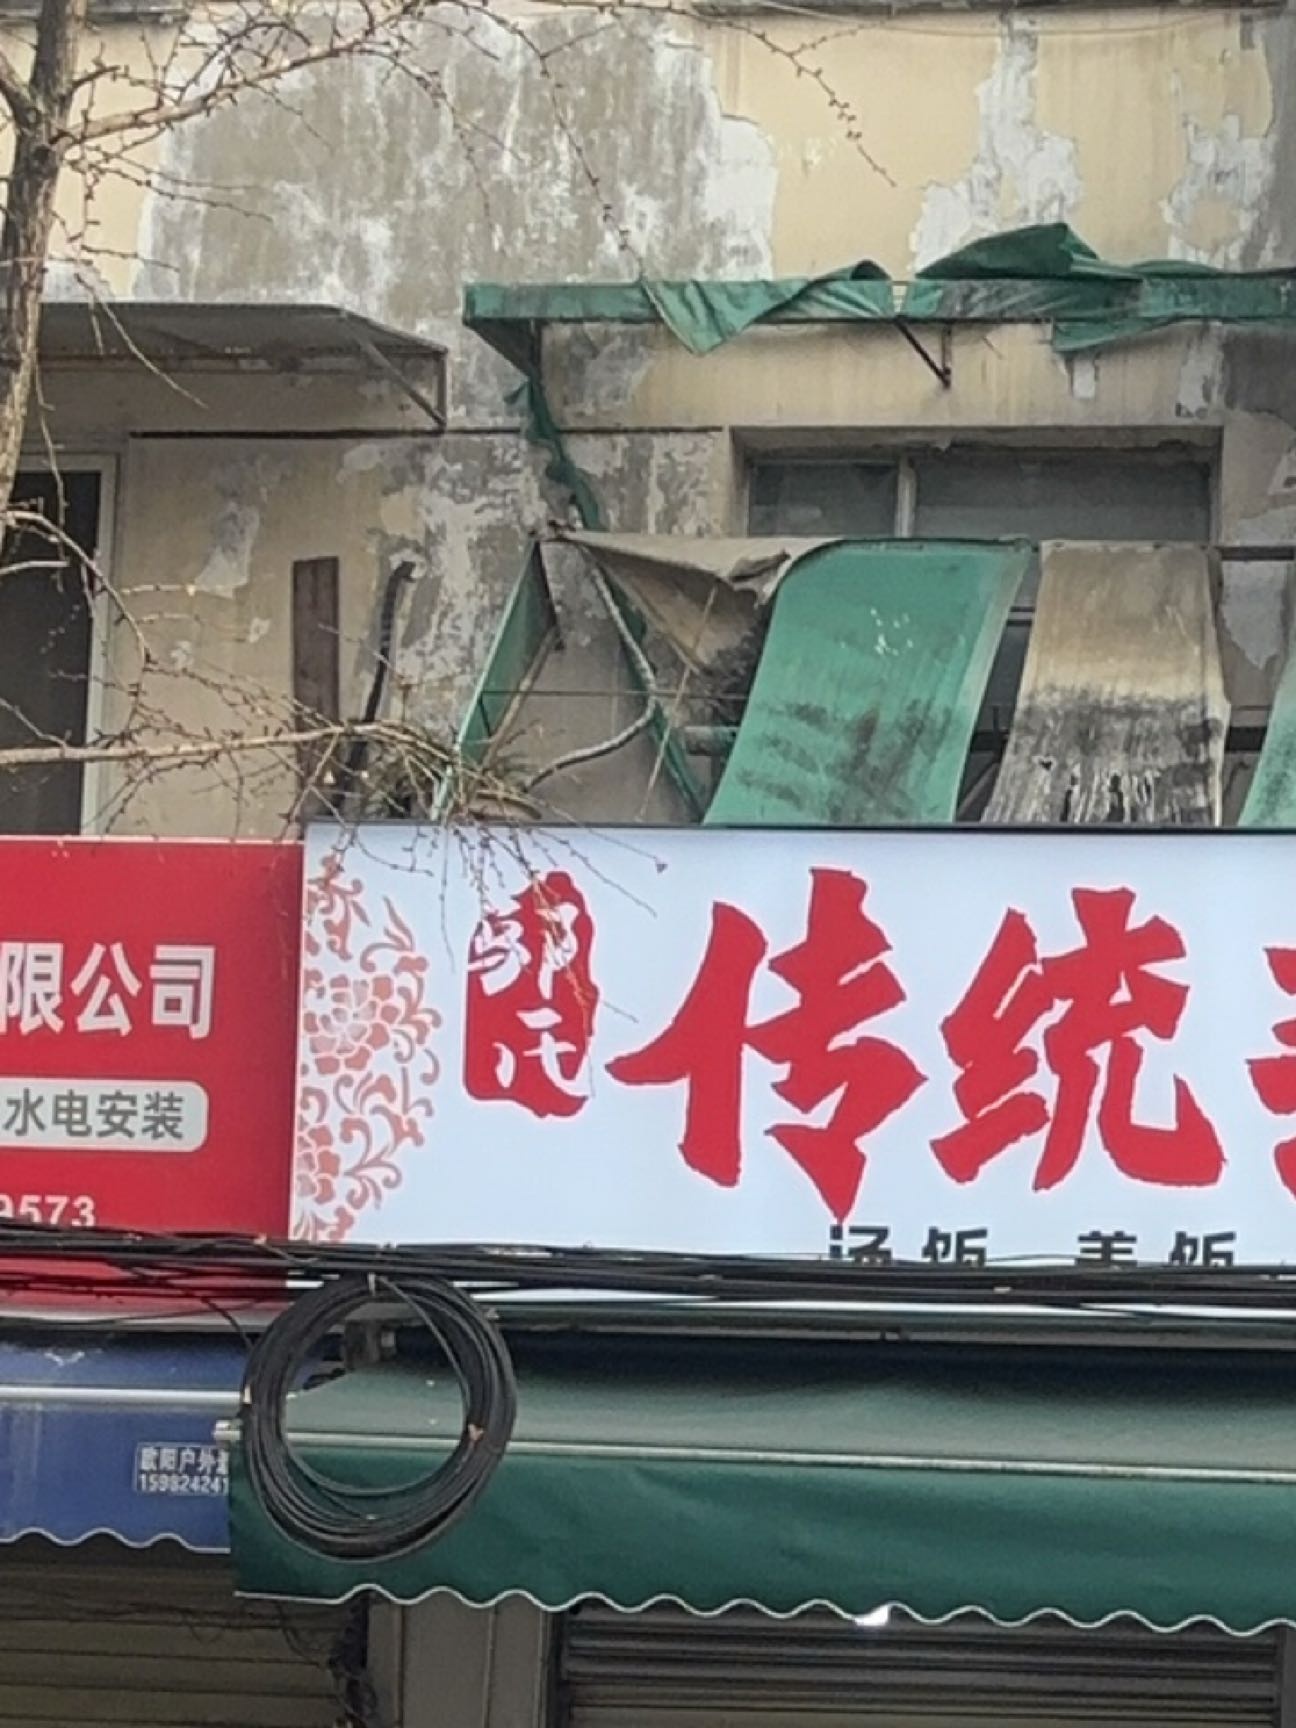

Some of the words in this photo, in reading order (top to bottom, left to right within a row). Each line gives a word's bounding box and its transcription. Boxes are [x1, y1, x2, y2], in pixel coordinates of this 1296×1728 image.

[0, 942, 215, 1039] 限公司
[4, 1088, 184, 1141] 水电安装
